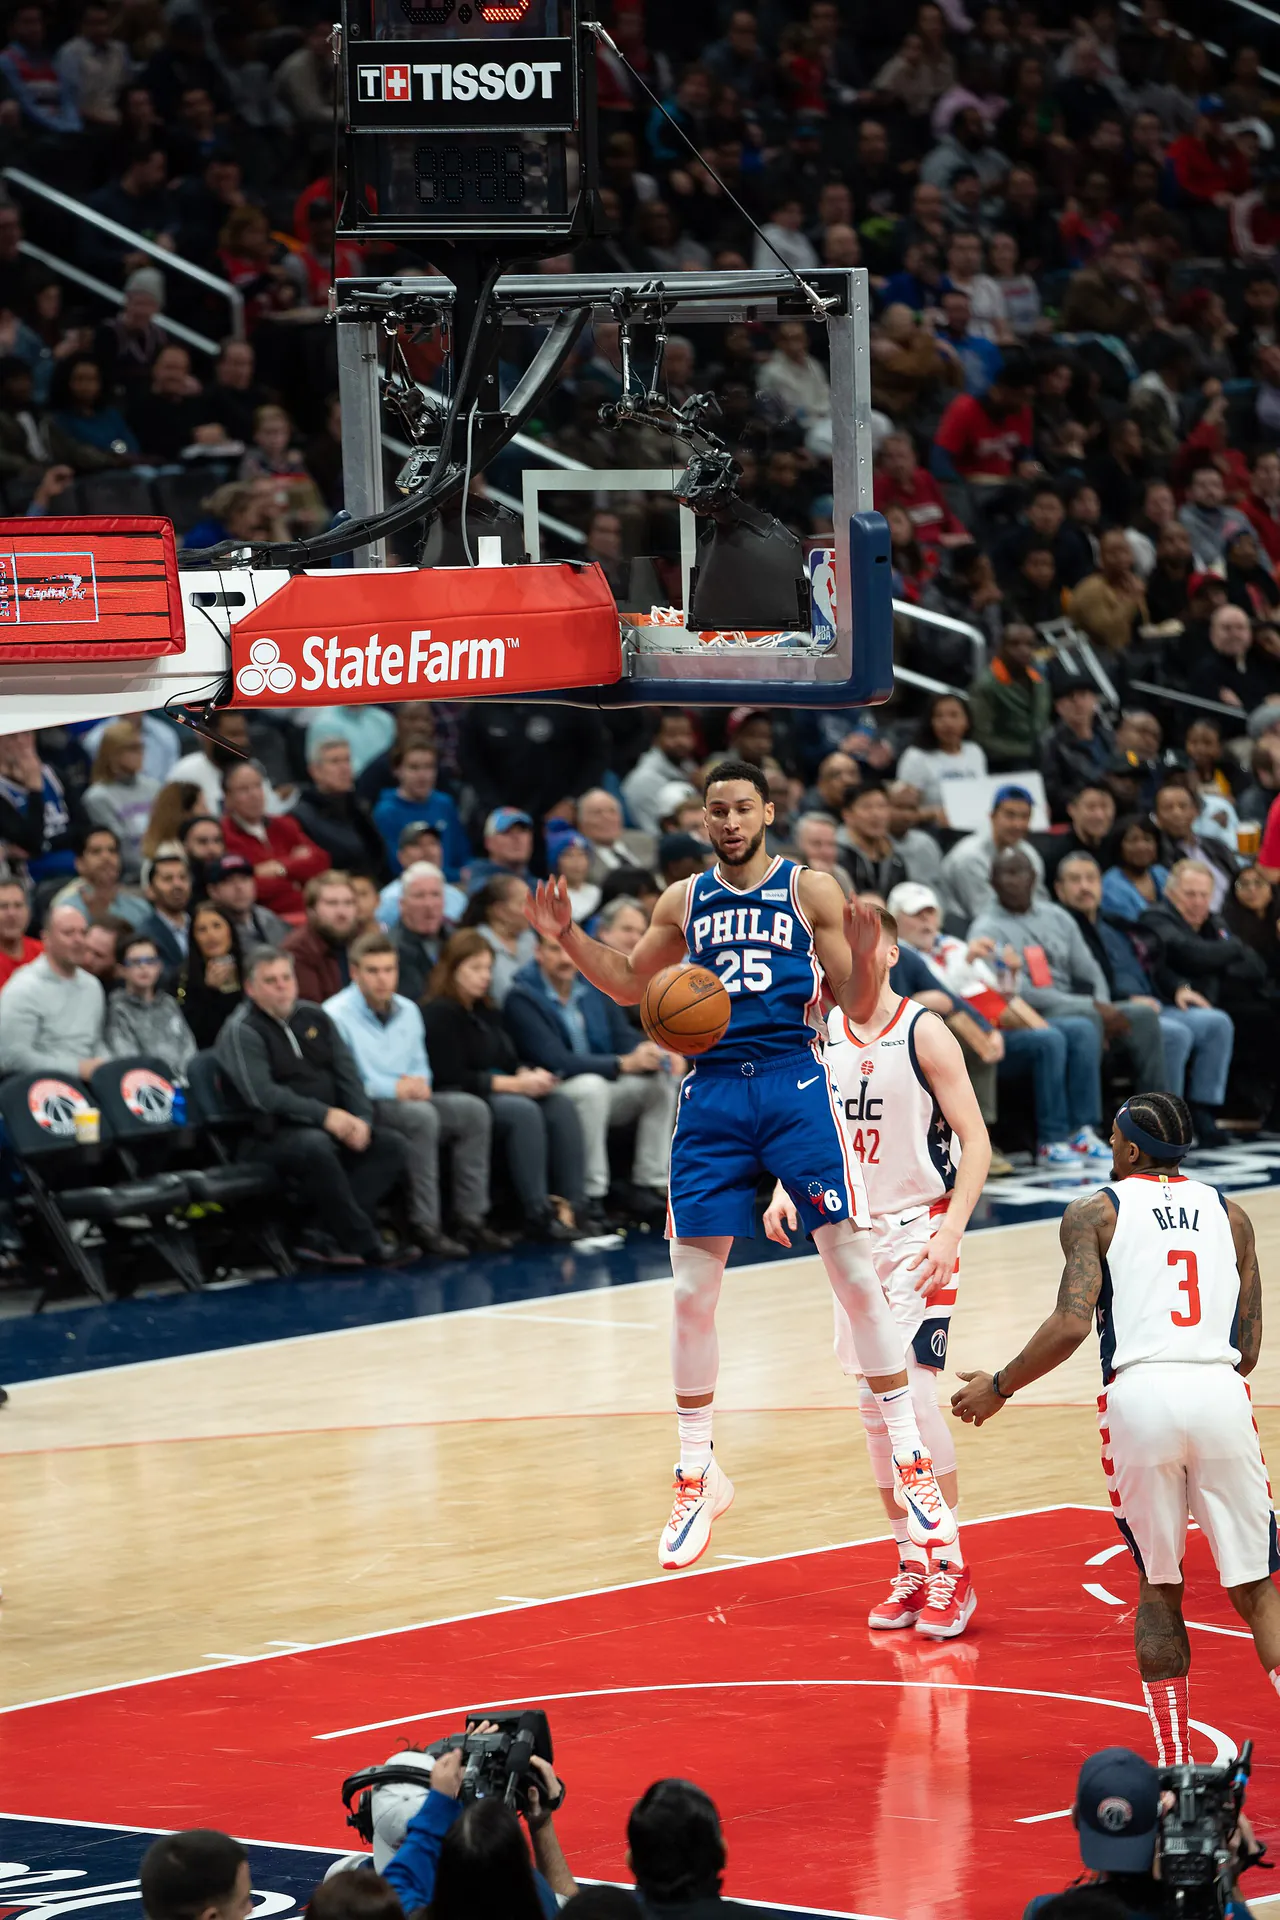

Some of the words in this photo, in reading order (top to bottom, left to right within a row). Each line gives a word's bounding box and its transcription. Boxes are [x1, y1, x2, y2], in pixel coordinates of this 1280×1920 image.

[412, 62, 562, 101] TISSOT
[693, 908, 793, 954] PHILA
[715, 949, 773, 992] 25
[852, 1128, 880, 1164] 42
[1152, 1206, 1200, 1232] BEAL
[1167, 1249, 1201, 1327] 3
